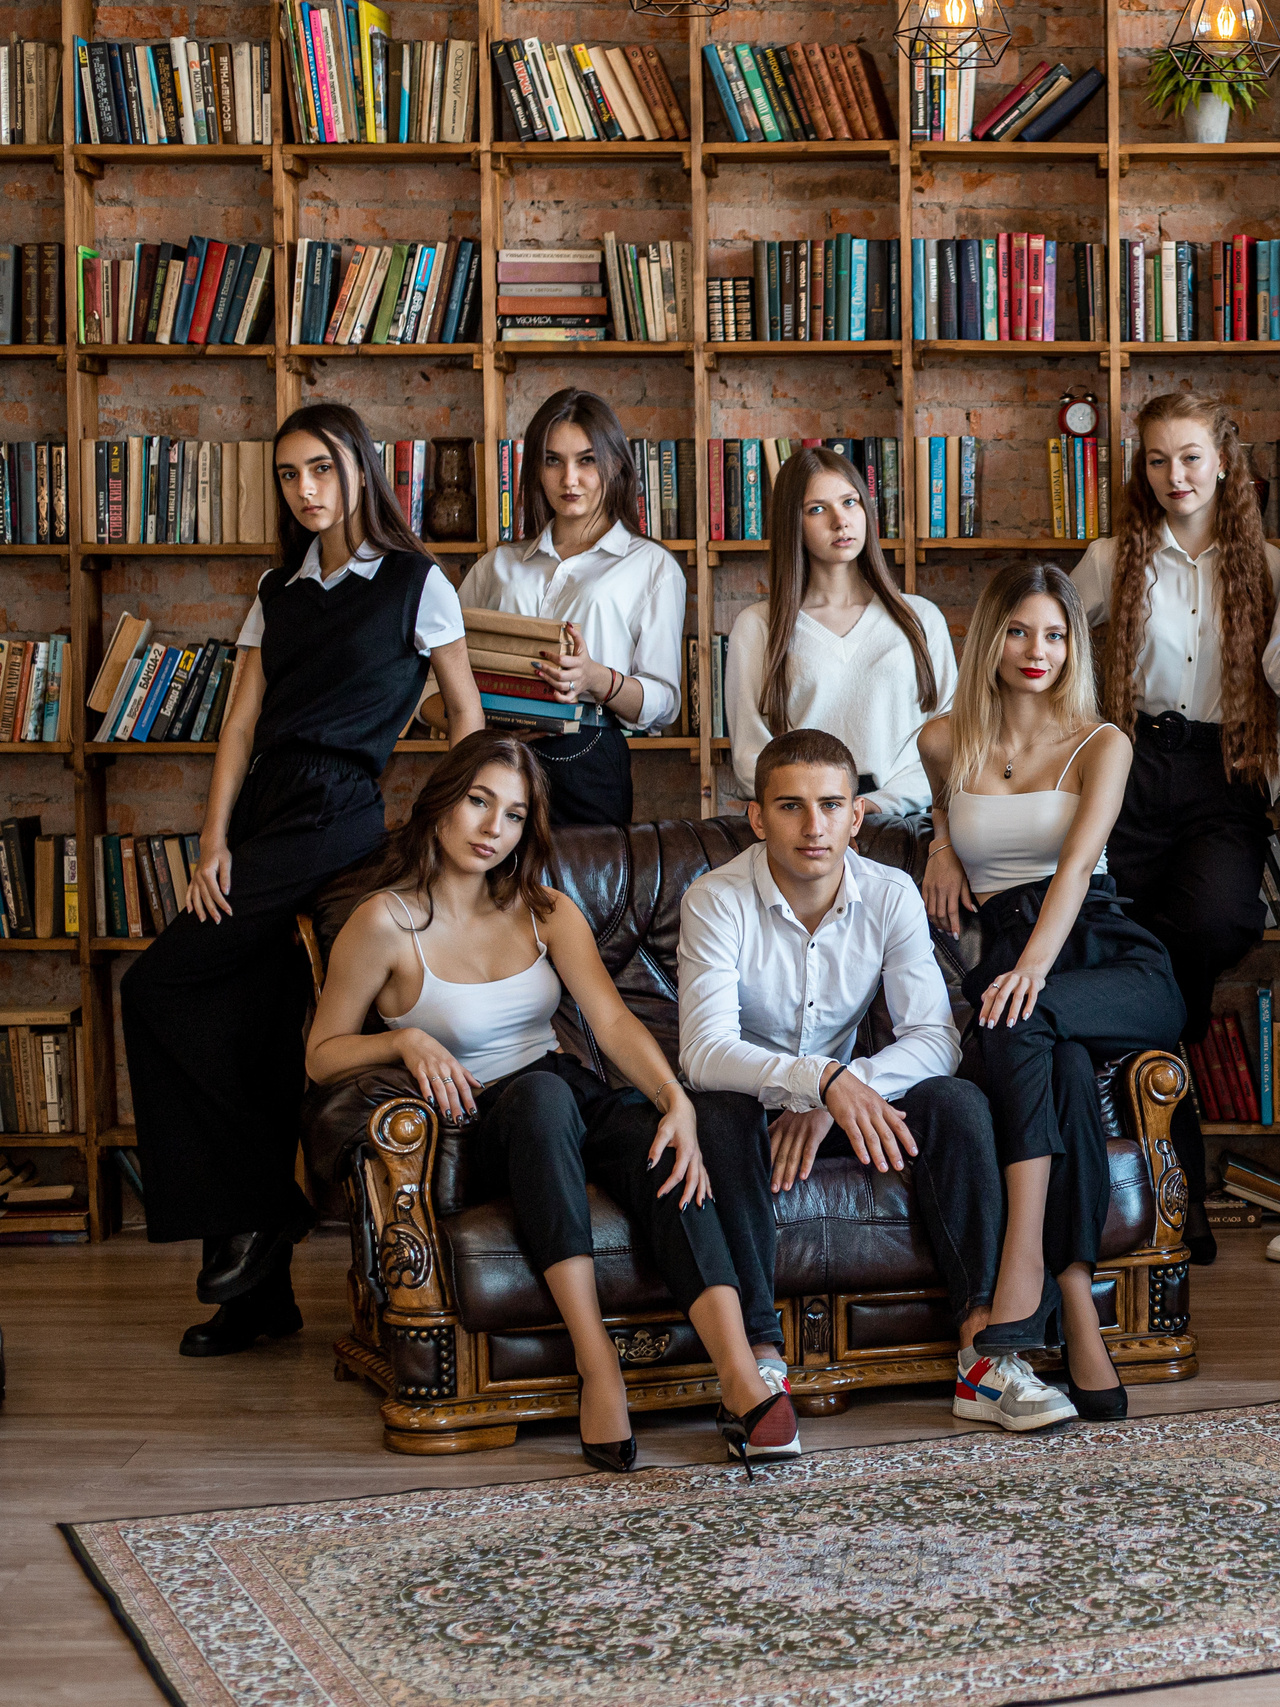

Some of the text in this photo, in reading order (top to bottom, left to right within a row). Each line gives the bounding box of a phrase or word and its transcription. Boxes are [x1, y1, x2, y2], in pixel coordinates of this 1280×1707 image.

[189, 60, 203, 103] ЧЕЛЮСТИ 2
[219, 56, 232, 132] БЕССМЕРТНЫЕ
[452, 48, 464, 99] МУЖЕСТВО
[513, 60, 533, 96] ТУМАН
[515, 316, 552, 324] УСТИНОВА
[963, 456, 972, 495] КОРСАР
[1053, 468, 1061, 501] ДЮМА
[109, 478, 122, 538] СТИВЕН КИНГ
[138, 648, 162, 691] БАНДА-2
[160, 682, 182, 717] Банда 3
